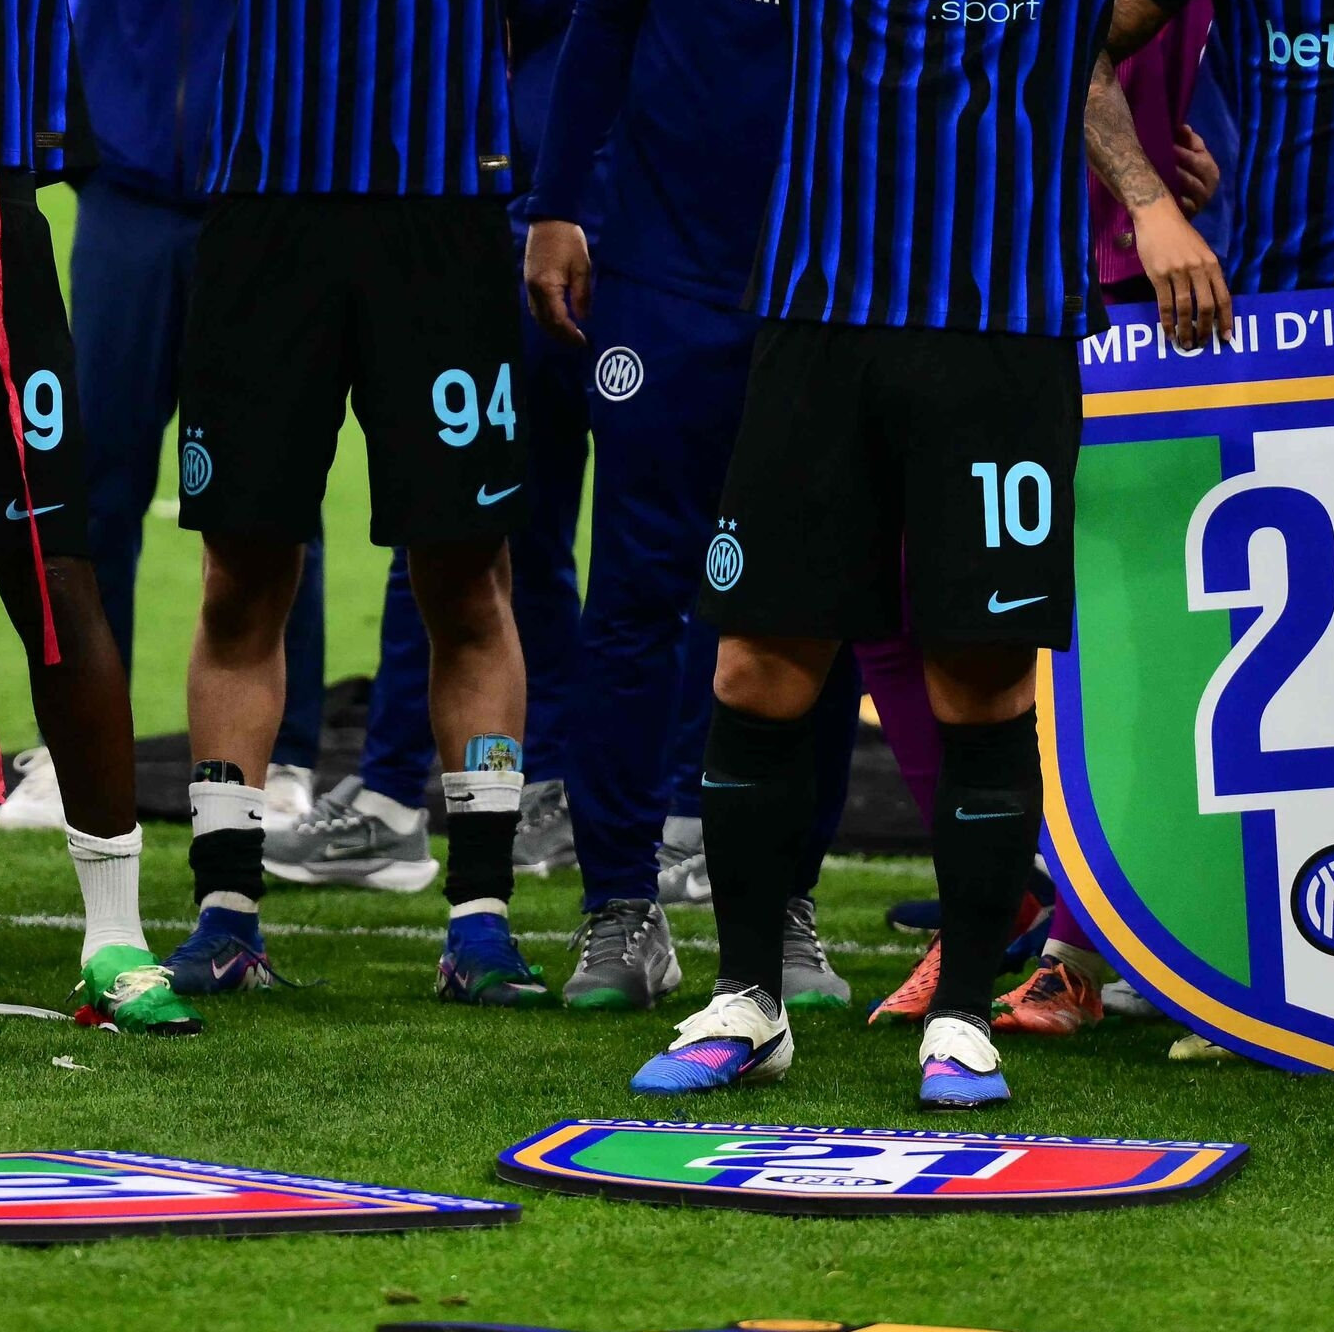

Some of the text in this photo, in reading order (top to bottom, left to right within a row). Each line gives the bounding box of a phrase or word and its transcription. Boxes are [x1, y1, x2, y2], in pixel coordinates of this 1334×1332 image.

[23, 370, 63, 450] 9
[432, 363, 516, 447] 94
[971, 461, 1051, 547] 10
[577, 1118, 843, 1134] CAMPIONI
[703, 1142, 1007, 1176] 21
